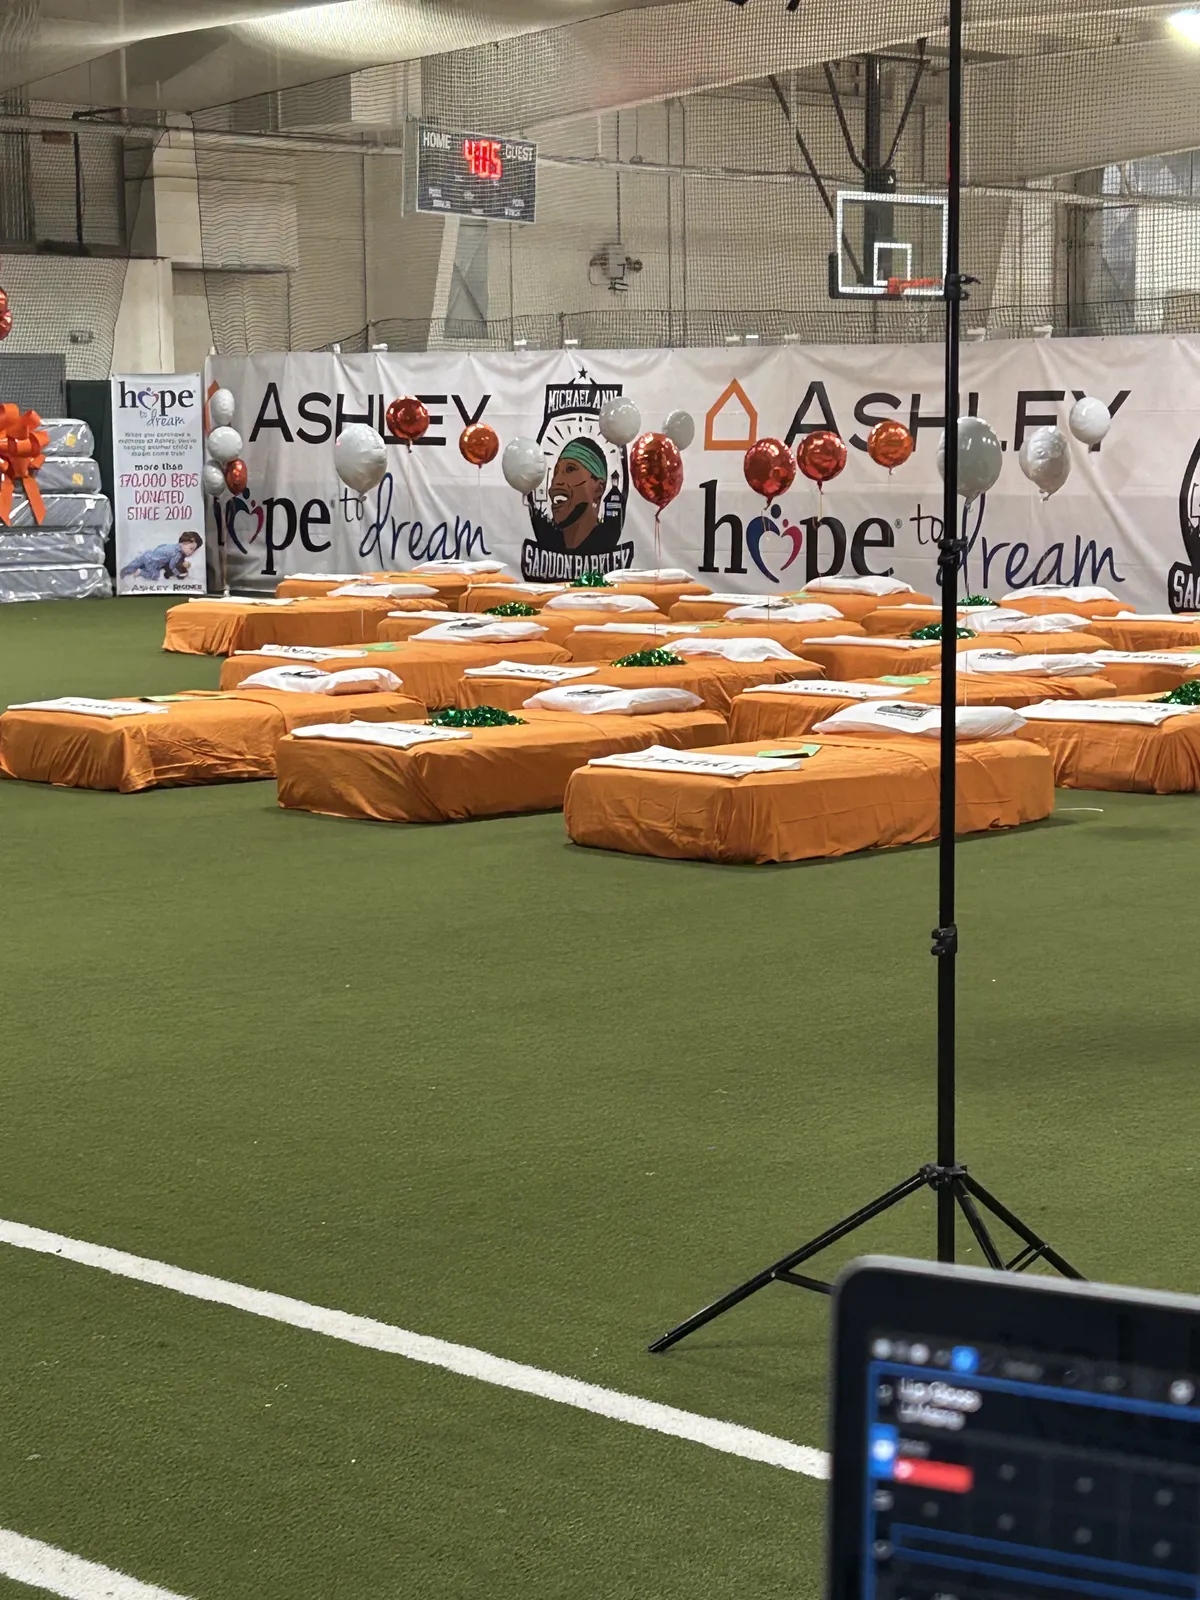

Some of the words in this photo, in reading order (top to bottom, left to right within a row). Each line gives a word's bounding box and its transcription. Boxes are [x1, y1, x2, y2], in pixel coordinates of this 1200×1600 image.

[424, 131, 452, 150] HOME
[505, 143, 534, 161] GUEST
[548, 389, 592, 414] MICHAEL
[146, 408, 186, 428] dream
[162, 462, 184, 471] than
[171, 472, 199, 488] BEDS
[134, 489, 184, 505] DONATED
[127, 506, 161, 521] SINCE
[165, 505, 193, 520] 2010
[359, 472, 491, 570] dream
[525, 544, 573, 580] SAQUON
